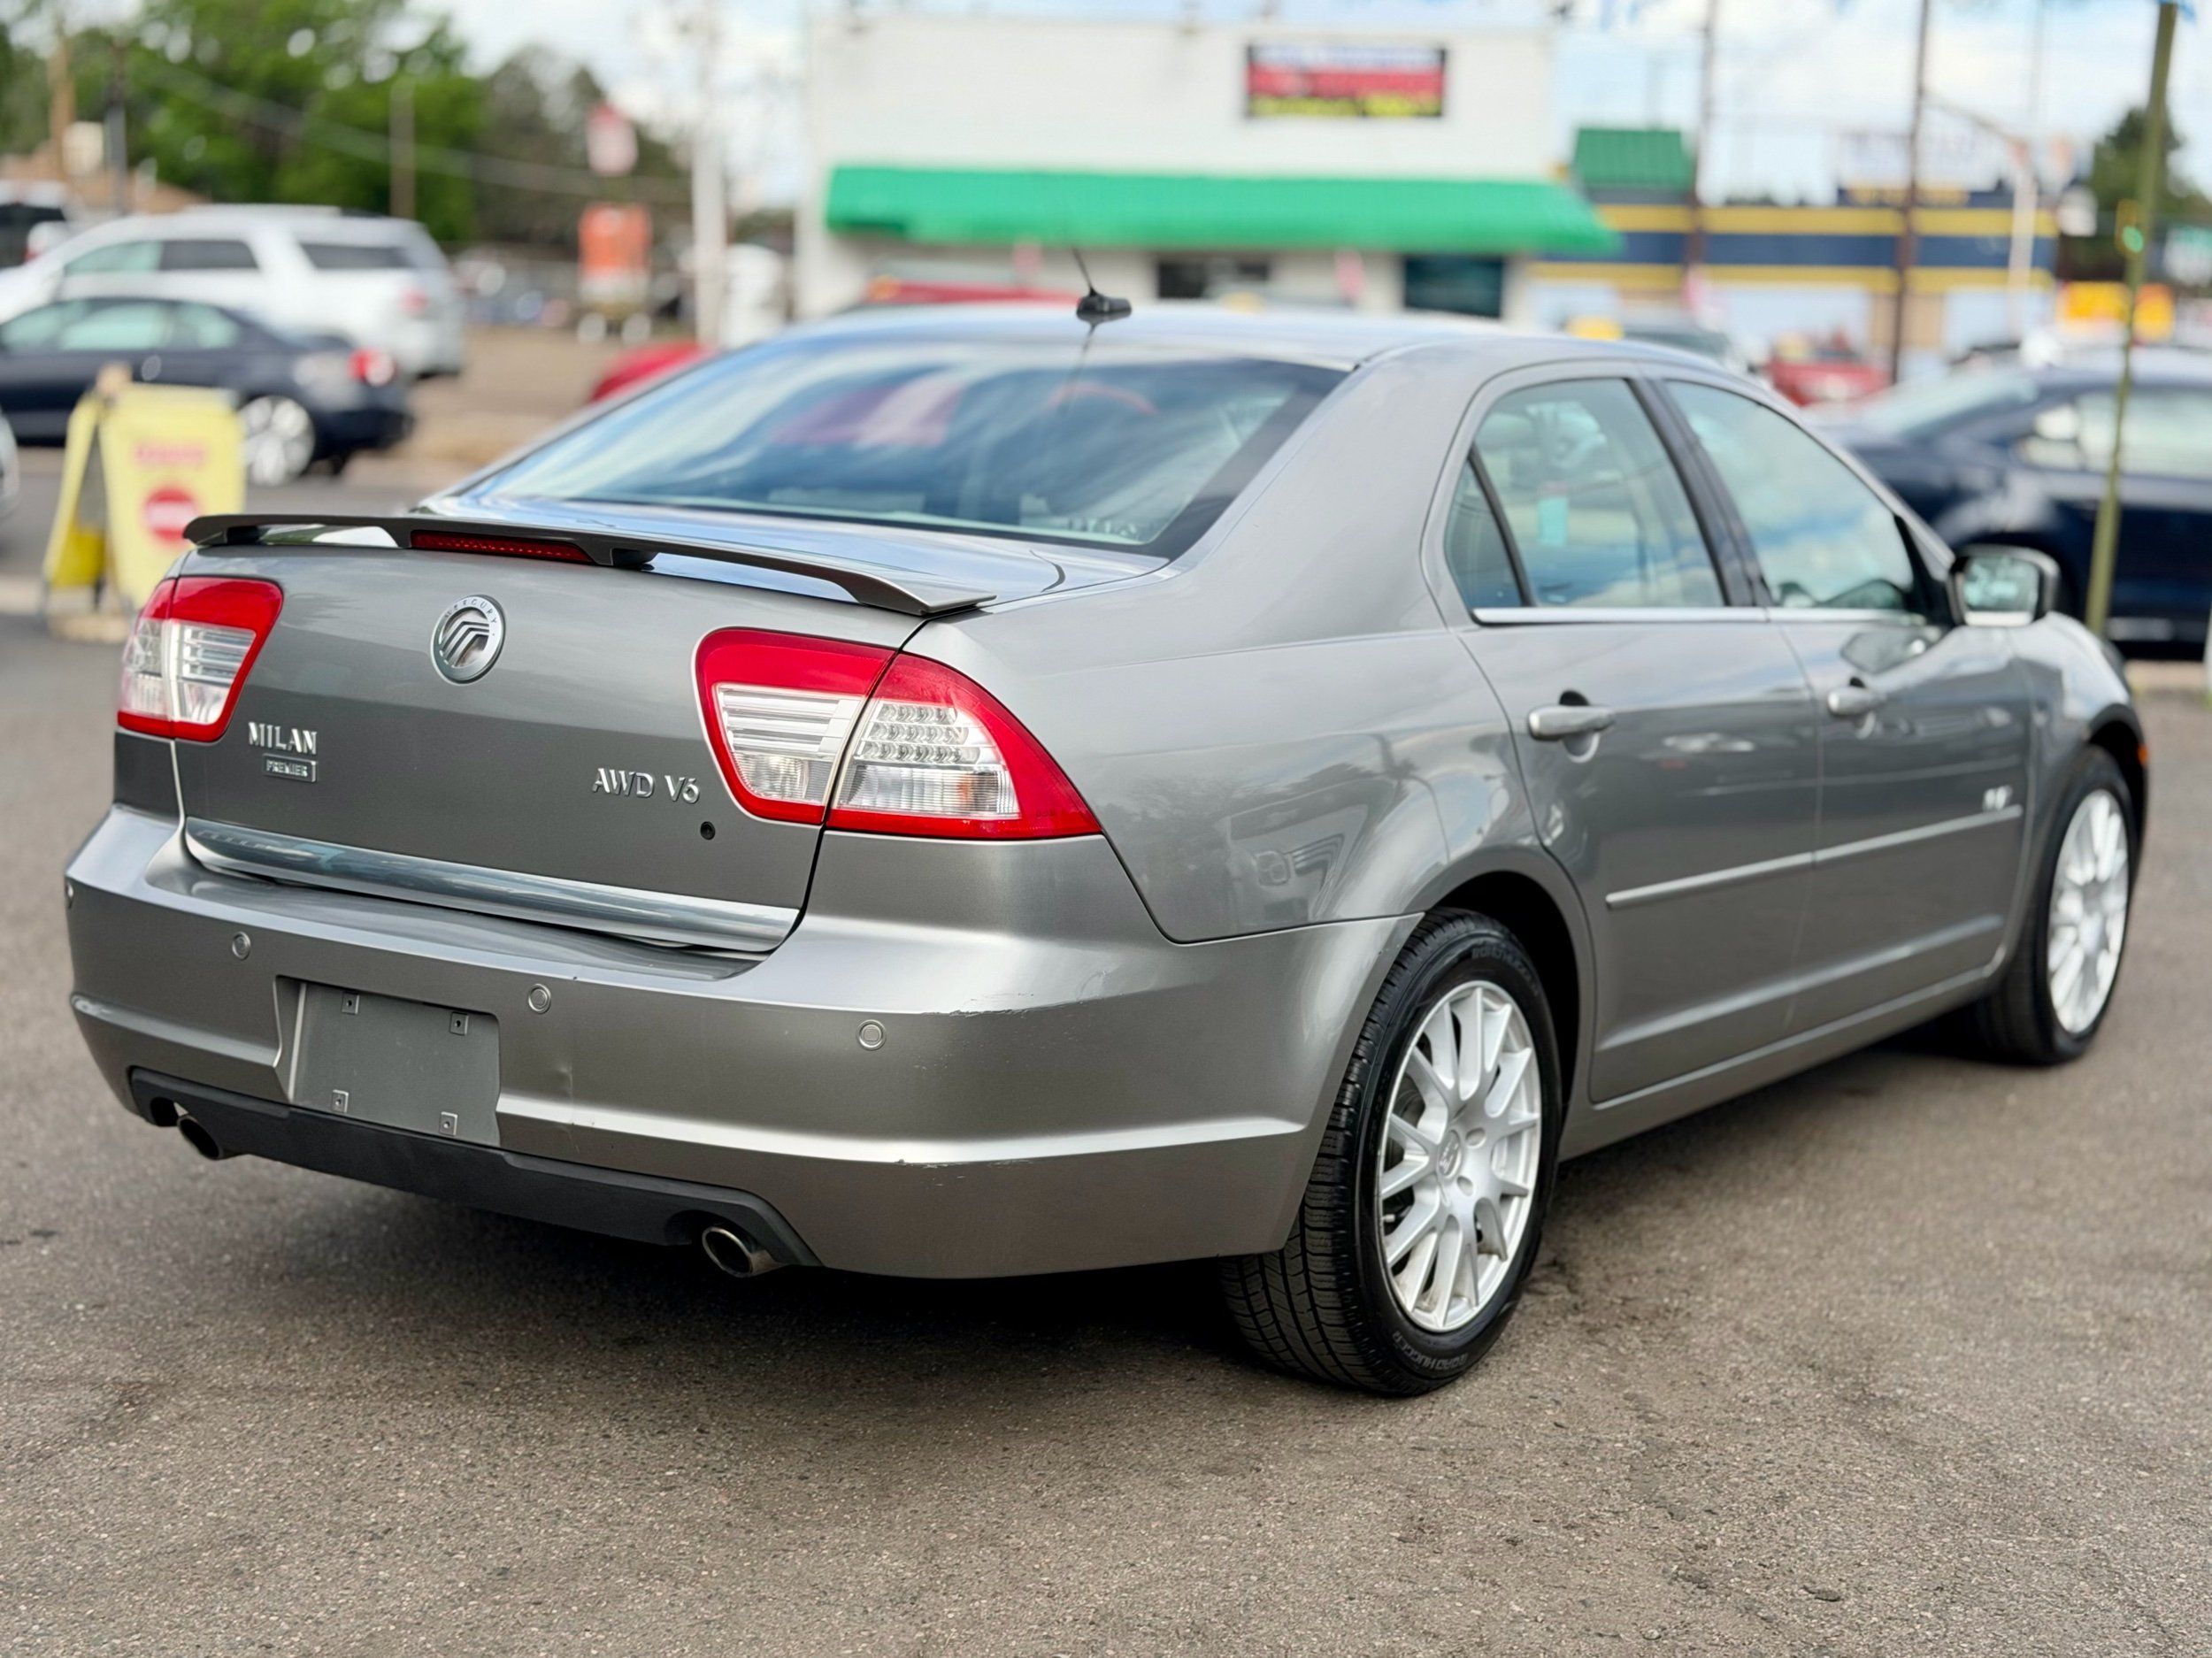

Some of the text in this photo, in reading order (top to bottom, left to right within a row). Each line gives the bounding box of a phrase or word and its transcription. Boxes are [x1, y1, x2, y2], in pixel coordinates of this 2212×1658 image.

[444, 598, 497, 624] MERCURY
[248, 721, 318, 755] MILAN
[266, 759, 309, 778] PREMIER
[592, 767, 701, 804] AWD V6
